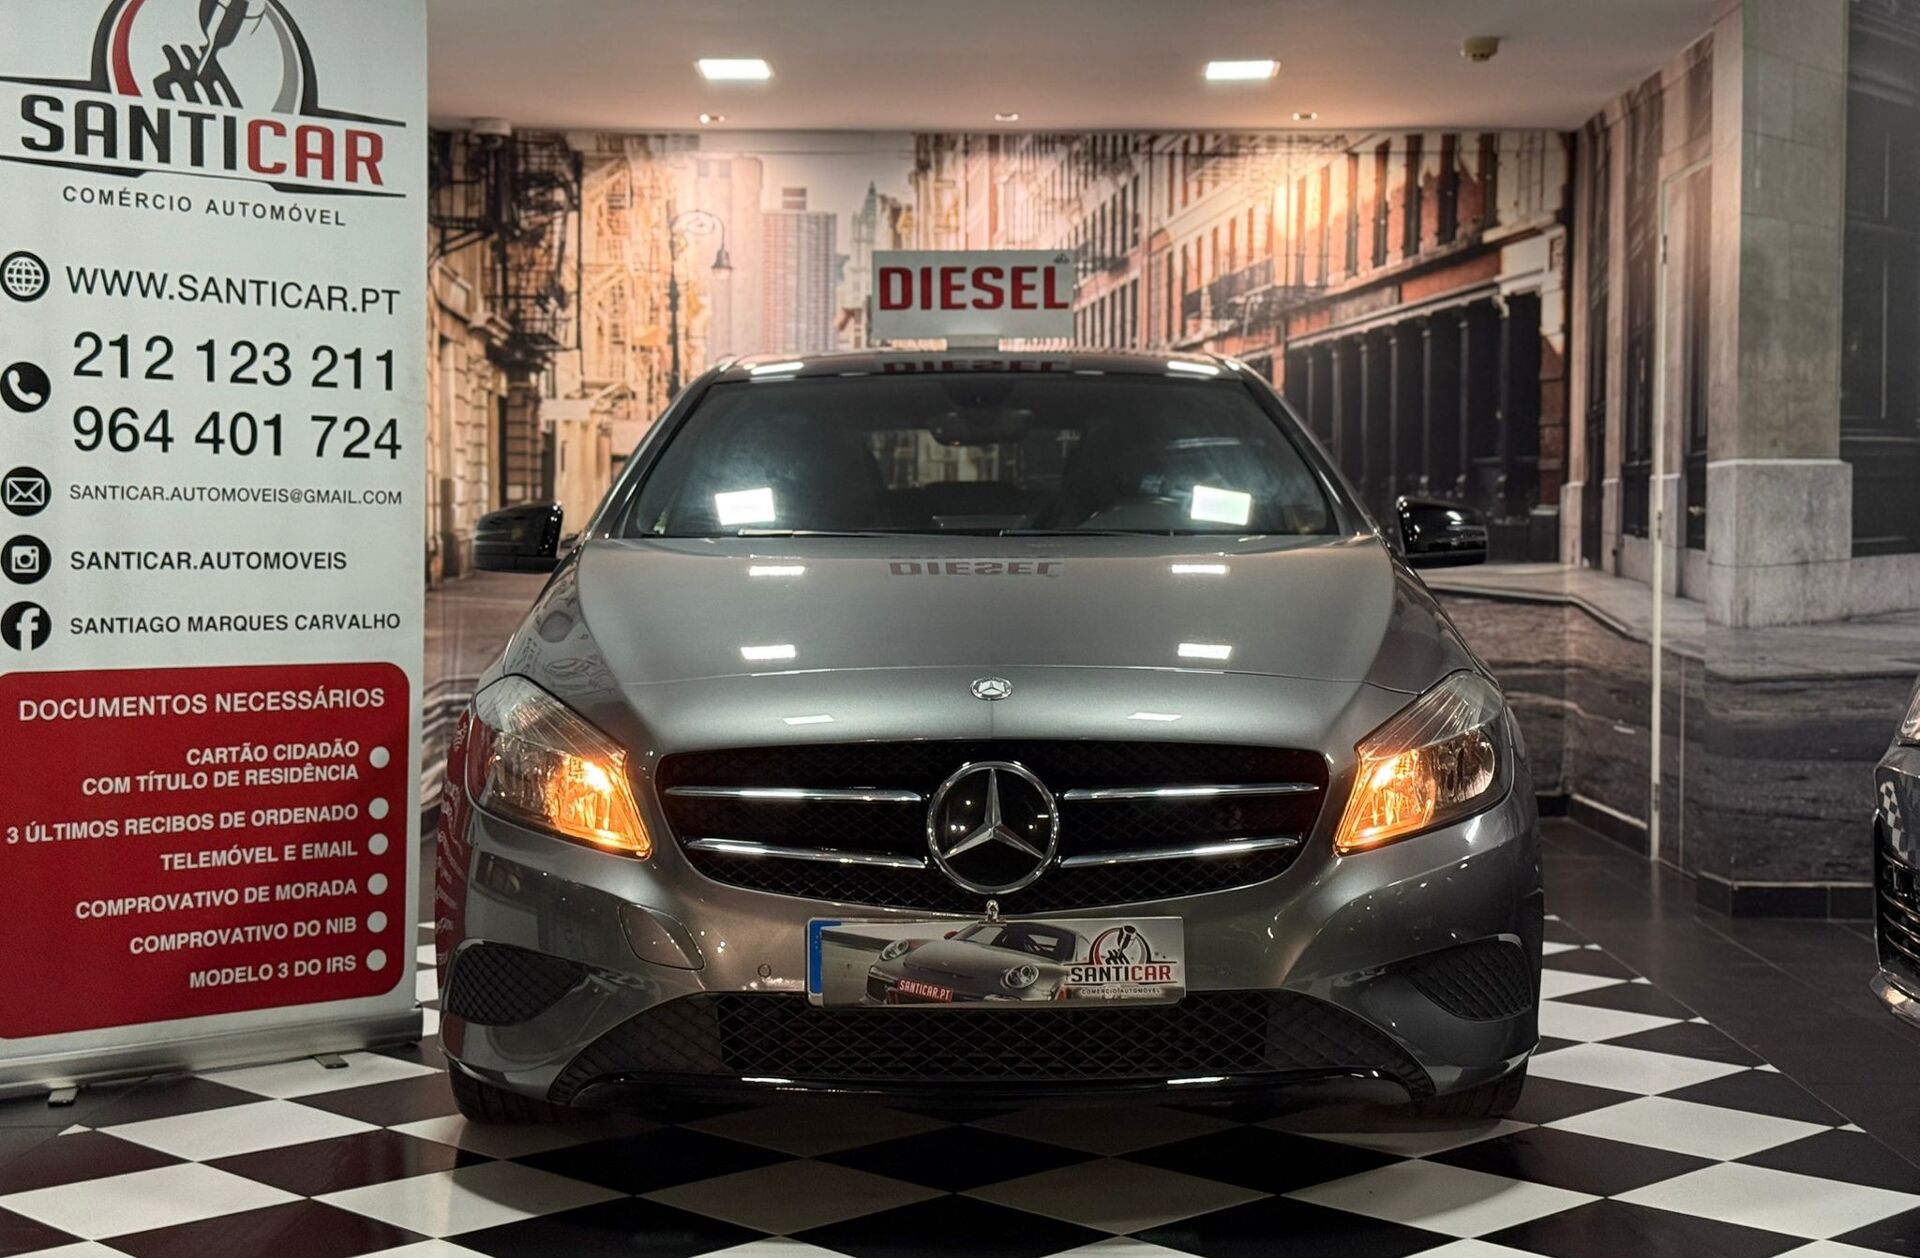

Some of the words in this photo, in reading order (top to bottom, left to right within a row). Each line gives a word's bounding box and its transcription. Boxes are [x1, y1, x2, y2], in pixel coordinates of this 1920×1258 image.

[21, 94, 384, 186] SANTICAR
[62, 186, 192, 212] COMÉRCIO
[205, 201, 346, 226] AUTOMÓVEL
[65, 265, 400, 315] WWW.SANTICAR.PT
[878, 266, 1070, 311] DIESEL
[73, 331, 174, 381] 212
[196, 339, 292, 386] 123
[311, 345, 394, 392] 211
[72, 405, 174, 453] 964
[195, 411, 283, 456] 401
[310, 415, 402, 460] 724
[70, 484, 402, 505] SANTICAR.AUTOMOVEIS@GMAIL.COM
[70, 551, 347, 570] SANTICAR.AUTOMOVEIS
[70, 616, 180, 634] SANTIAGO
[187, 615, 288, 633] MARQUES
[295, 613, 400, 630] CARVALHO
[19, 694, 207, 722] DOCUMENTOS
[215, 685, 385, 713] NECESSÁRIOS
[186, 742, 267, 766] CARTÃO
[273, 739, 359, 761] CIDADÃO
[83, 777, 131, 796] COM
[136, 770, 208, 792] TÍTULO
[213, 771, 240, 788] DE
[245, 763, 359, 785] RESIDÊNCIA
[7, 826, 19, 844] 3
[26, 816, 119, 843] ÚLTIMOS
[125, 814, 214, 836] RECIBOS
[220, 812, 245, 829] DE
[251, 804, 358, 827] ORDENADO
[161, 845, 278, 871] TELEMÓVEL
[284, 845, 296, 861] E
[302, 841, 358, 860] EMAIL
[76, 890, 239, 920] COMPROVATIVO
[244, 887, 270, 904] DE
[275, 880, 357, 901] MORADA
[130, 924, 288, 955] COMPROVATIVO
[294, 921, 320, 937] DO
[326, 917, 356, 935] NIB
[190, 964, 272, 989] MODELO
[278, 963, 288, 978] 3
[295, 959, 321, 977] DO
[326, 956, 356, 973] IRS
